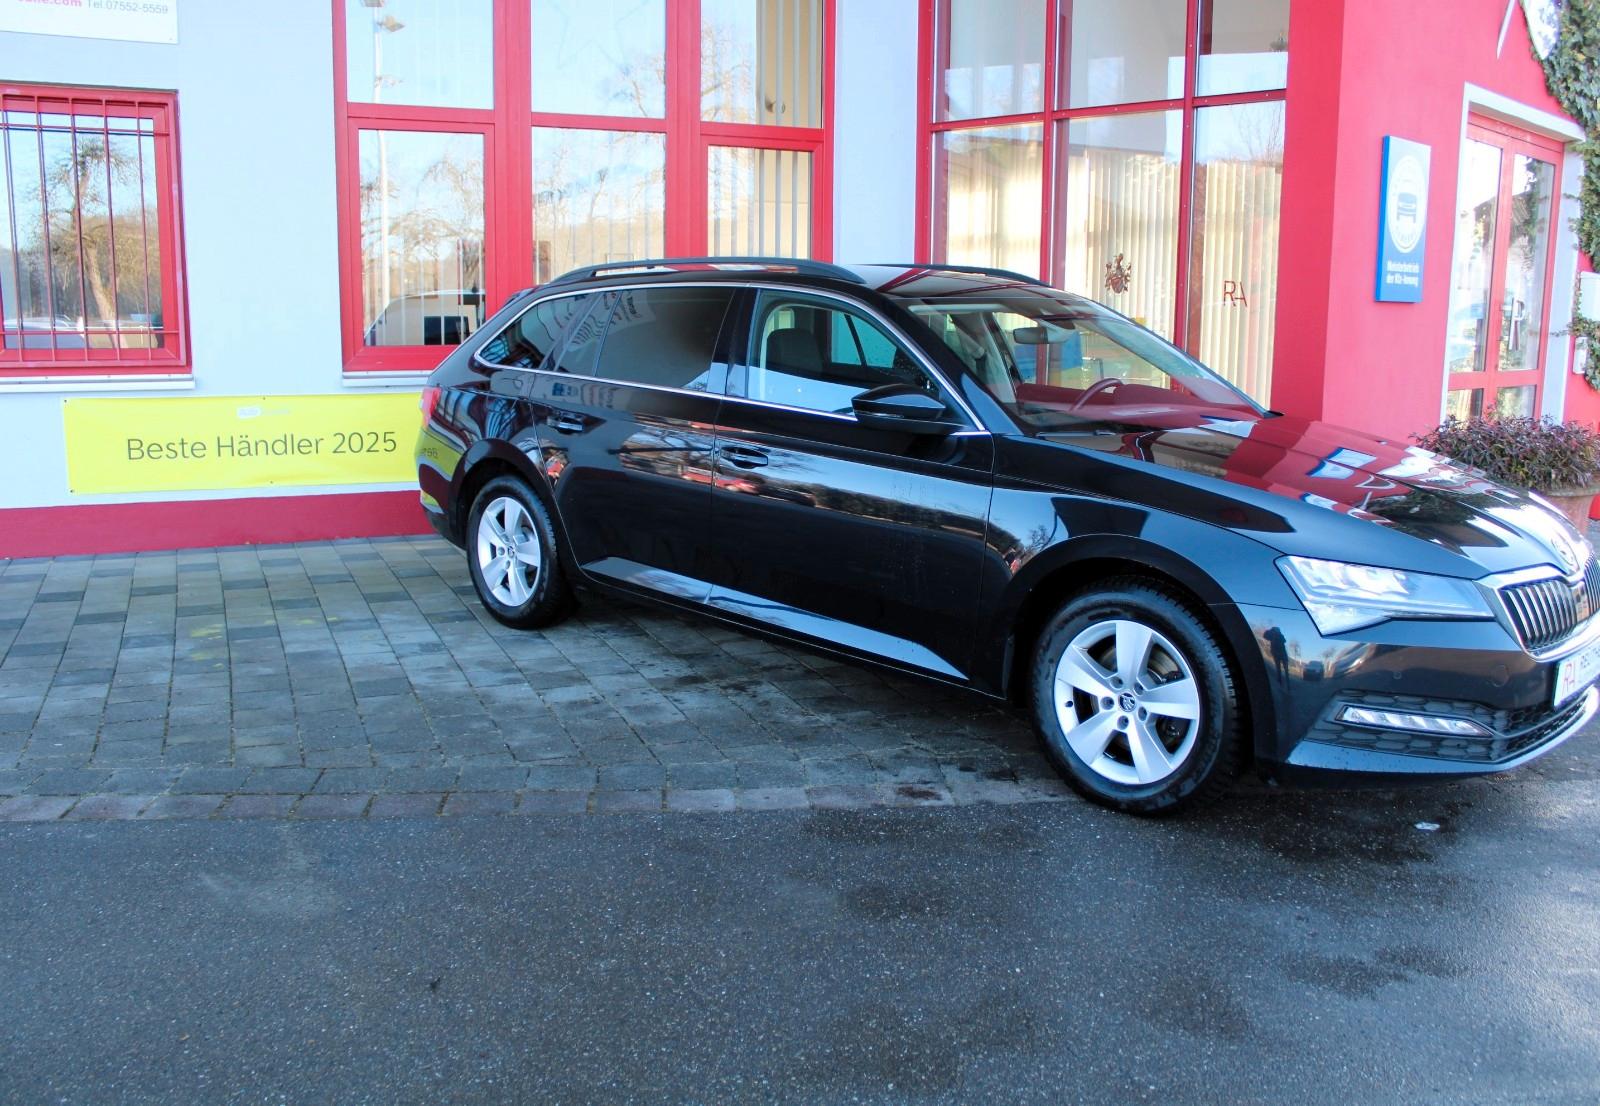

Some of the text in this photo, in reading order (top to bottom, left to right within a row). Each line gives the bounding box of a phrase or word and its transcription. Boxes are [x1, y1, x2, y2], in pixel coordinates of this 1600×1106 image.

[126, 437, 207, 461] Beste
[216, 434, 325, 458] Händler
[331, 431, 398, 455] 2025
